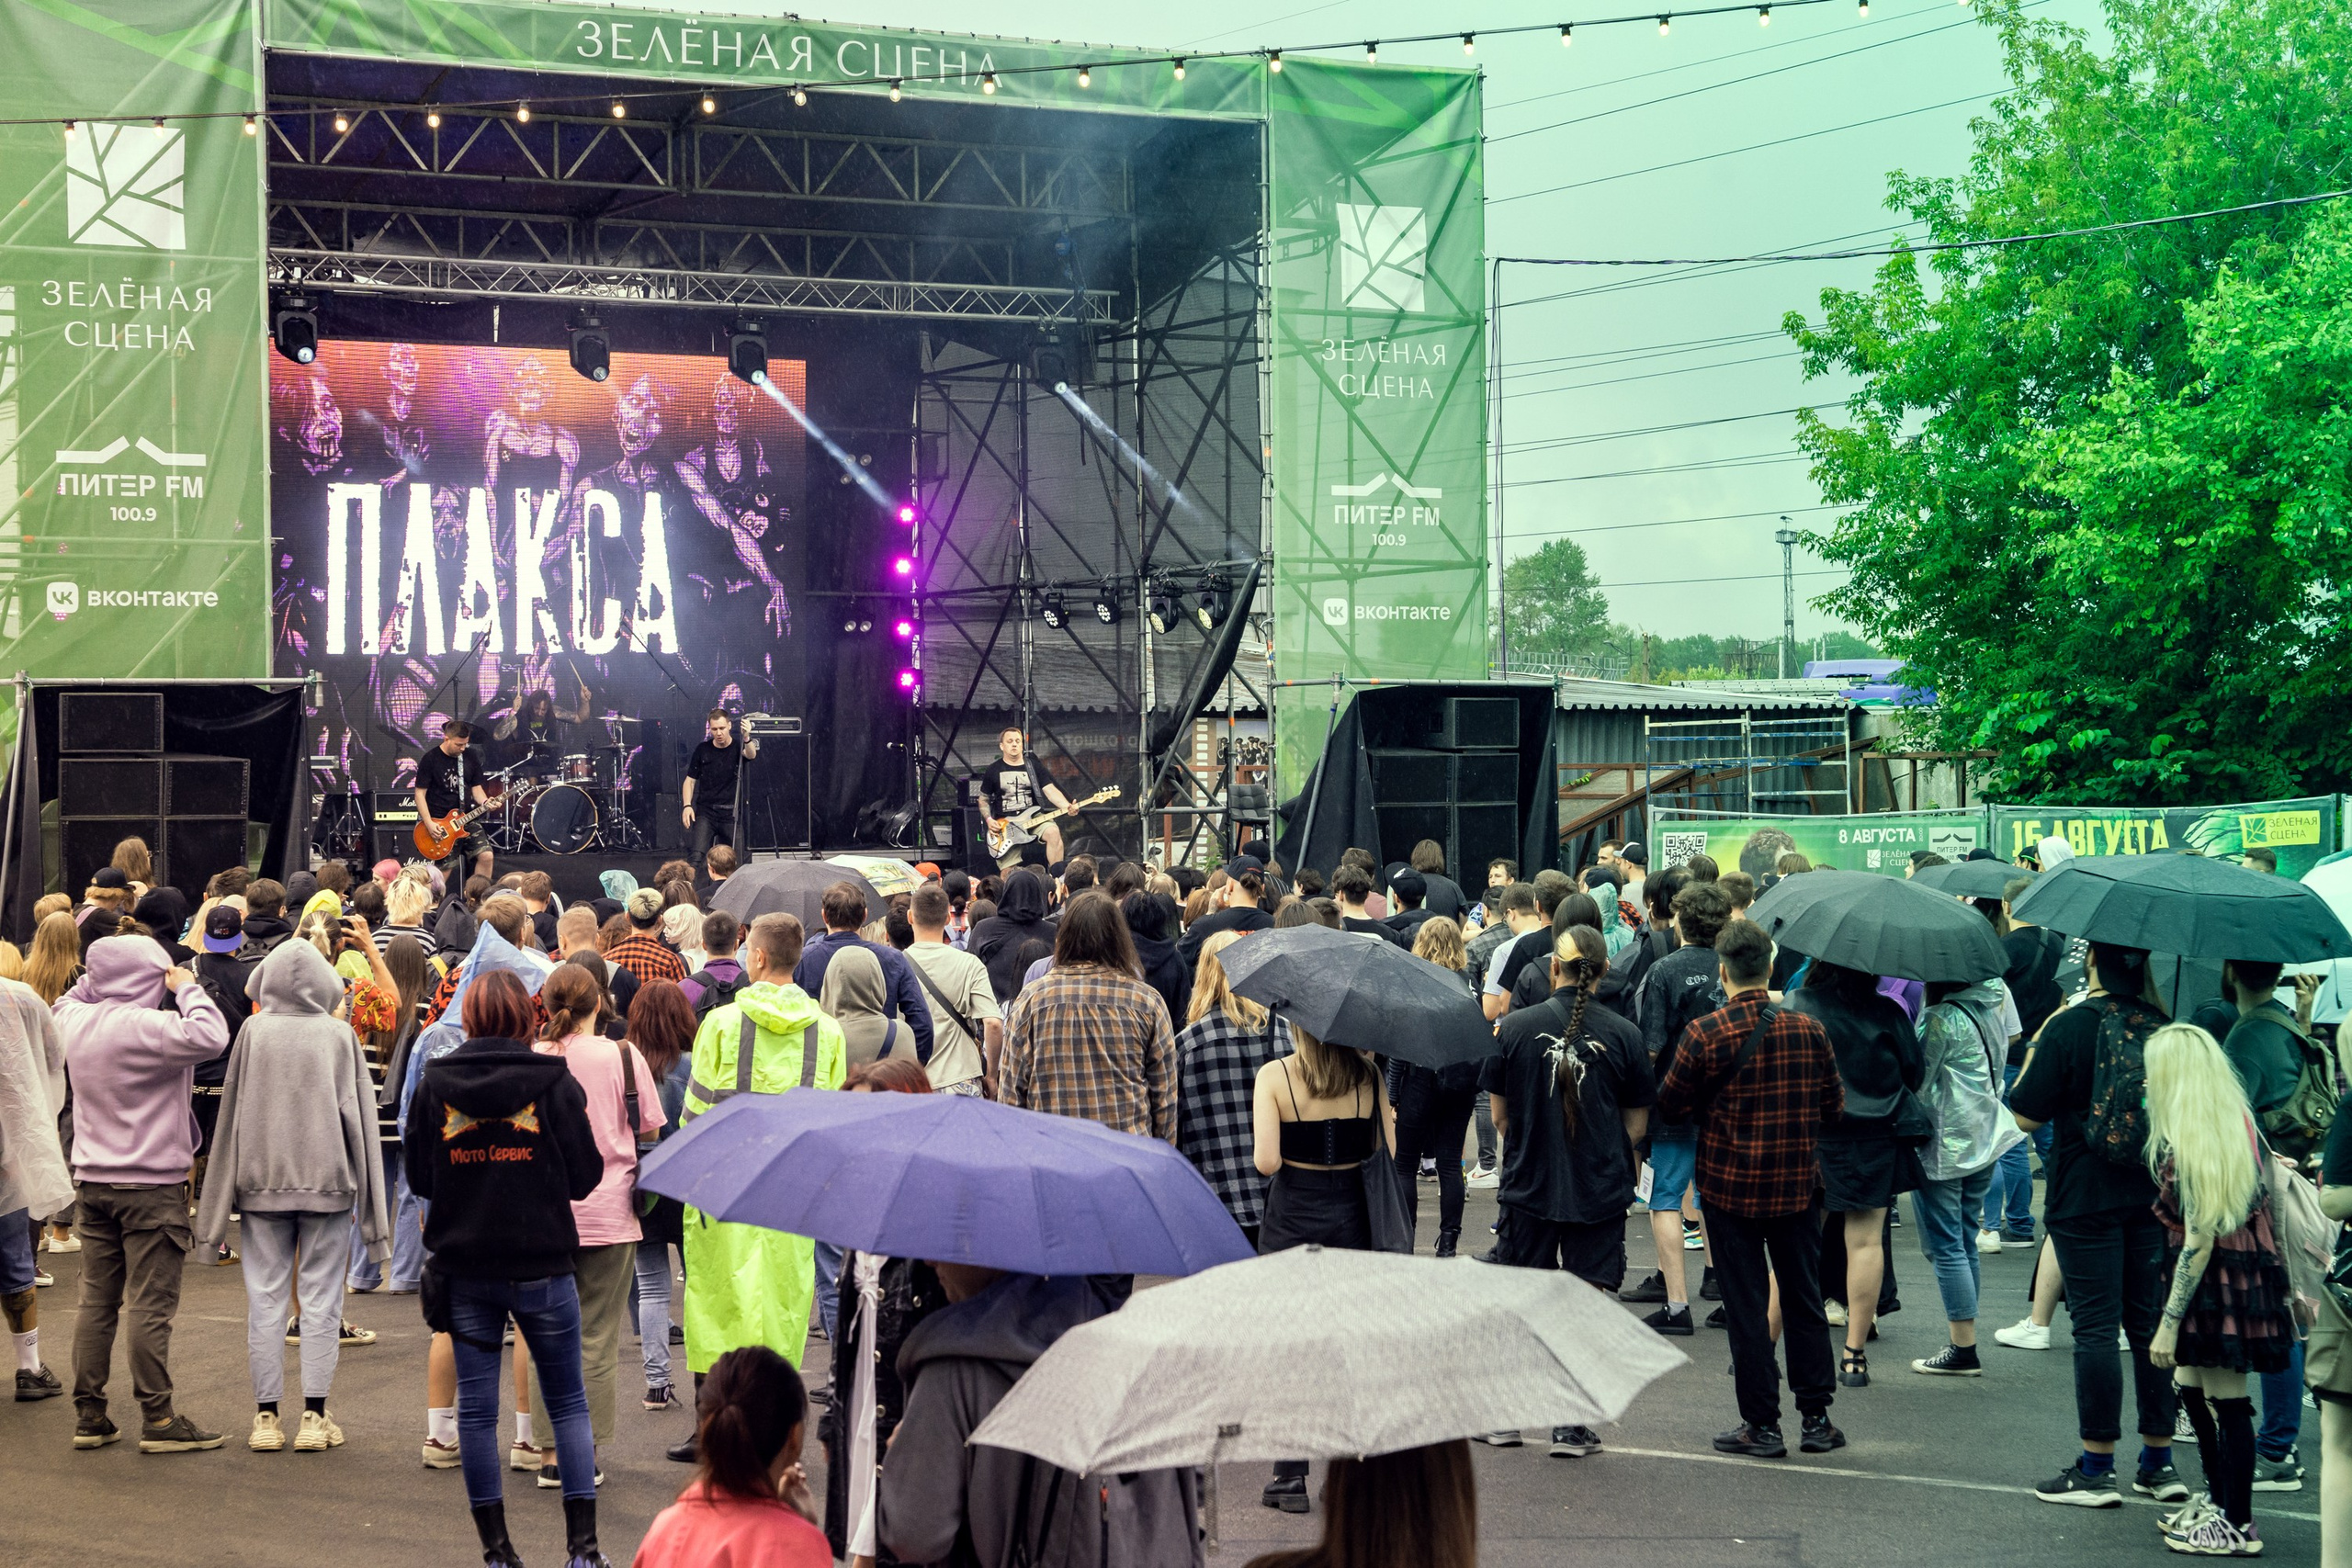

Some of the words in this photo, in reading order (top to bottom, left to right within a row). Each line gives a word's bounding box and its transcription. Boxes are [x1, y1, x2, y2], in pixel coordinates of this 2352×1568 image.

[576, 18, 812, 72] ЗЕЛЁНАЯ
[837, 39, 1003, 88] СЦЕНА
[42, 277, 212, 313] ЗЕЛЁНАЯ
[64, 321, 196, 352] СЦЕНА
[1321, 335, 1447, 366] ЗЕЛЁНАЯ
[1338, 373, 1435, 400] СЦЕНА
[60, 473, 156, 497] ПИТЕР
[165, 476, 203, 499] FM
[110, 506, 157, 522] 100.9
[1334, 504, 1406, 526] ПИТЕР
[1412, 506, 1440, 526] FM
[1372, 533, 1407, 547] 100.9
[326, 482, 679, 655] ПЛАКСА
[87, 590, 220, 608] вконтакте
[1354, 605, 1452, 621] вконтакте
[1838, 829, 1848, 843] 8
[1852, 828, 1916, 843] АВГУСТА
[2012, 820, 2044, 857] 16
[2270, 829, 2307, 840] СЦЕНА
[1881, 849, 1916, 858] ЗЕЛЁНА
[450, 1147, 487, 1166] Мото
[489, 1145, 534, 1162] Сервис
